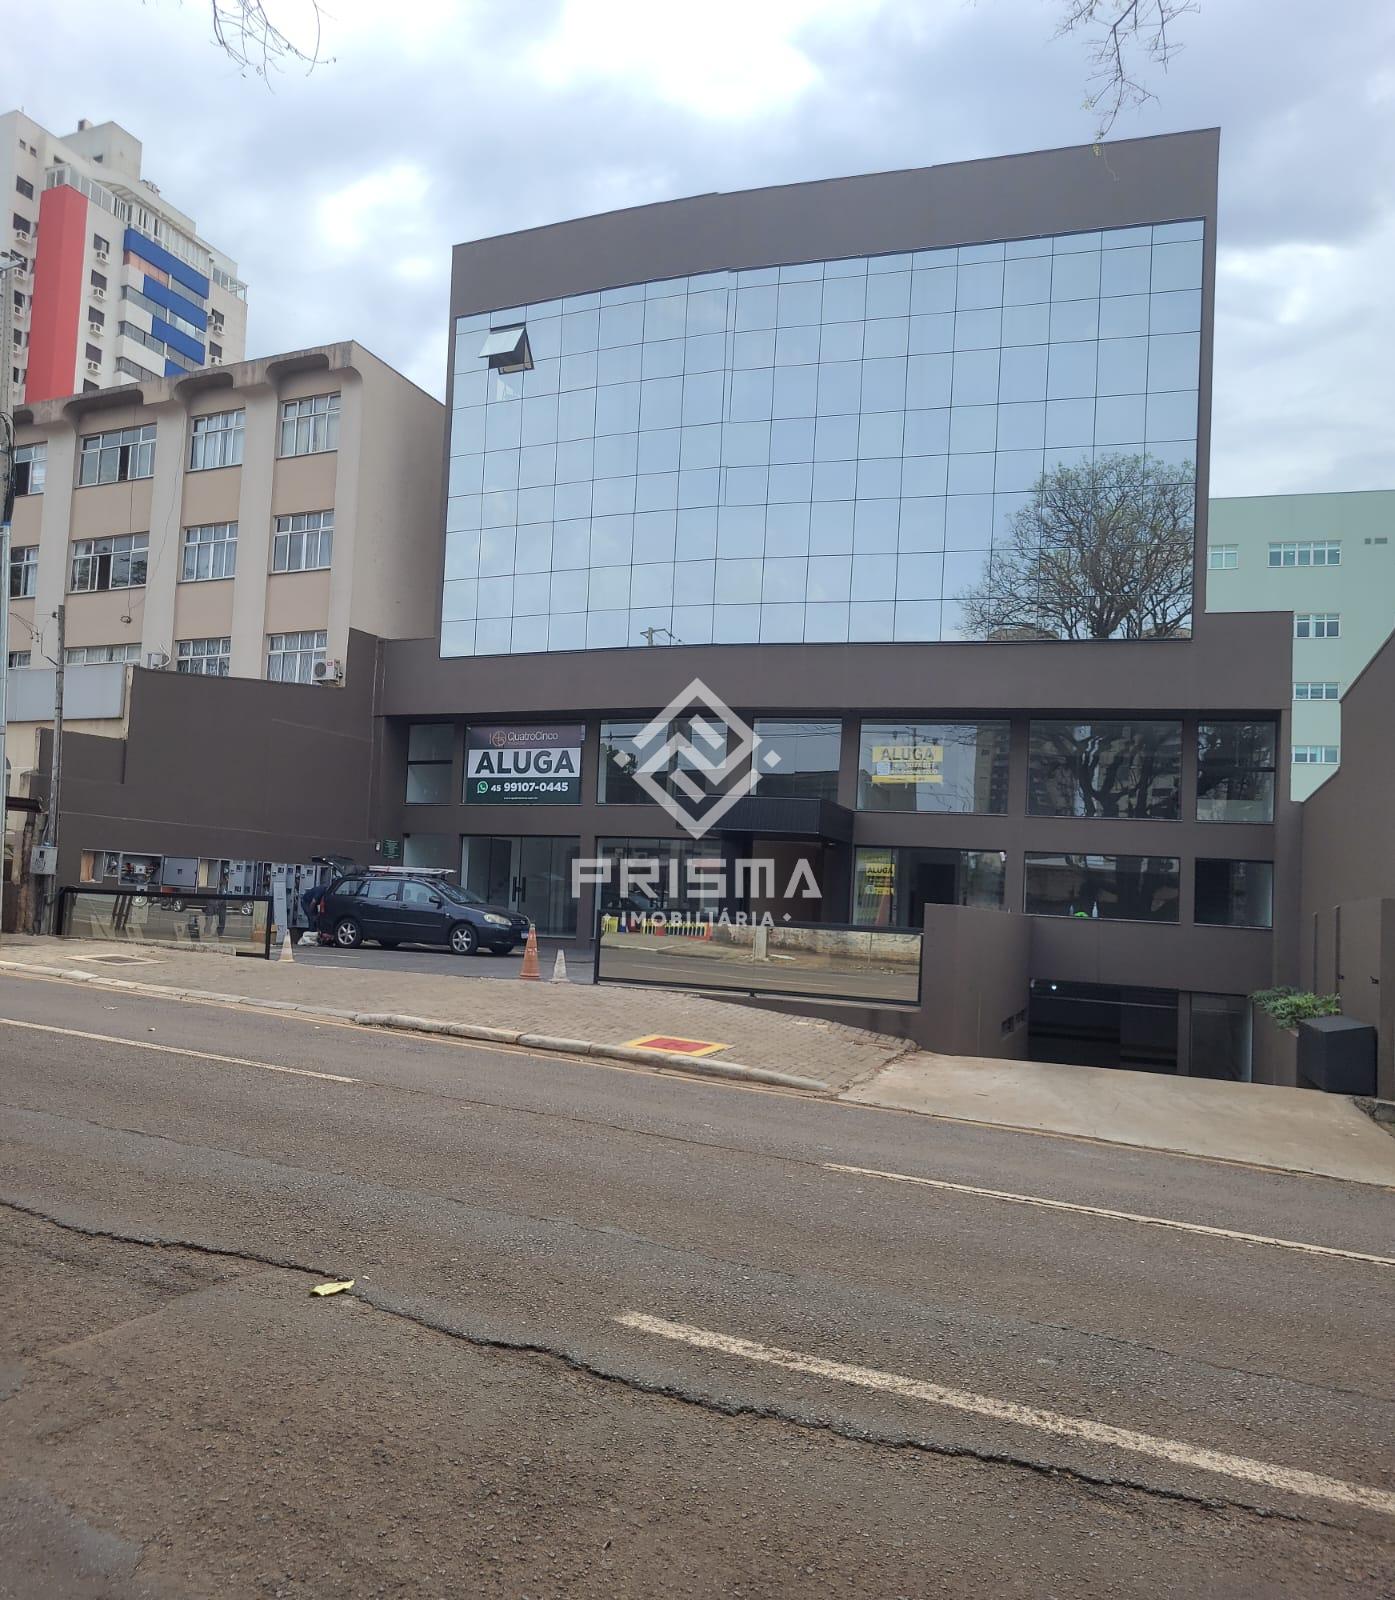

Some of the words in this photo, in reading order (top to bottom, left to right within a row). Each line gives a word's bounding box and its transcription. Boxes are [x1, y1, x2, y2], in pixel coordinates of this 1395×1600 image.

[507, 731, 559, 742] QuatroCinco
[881, 747, 935, 761] ALUGA
[475, 750, 575, 774] ALUGA
[491, 784, 502, 792] 45
[503, 782, 569, 792] 99107-0445
